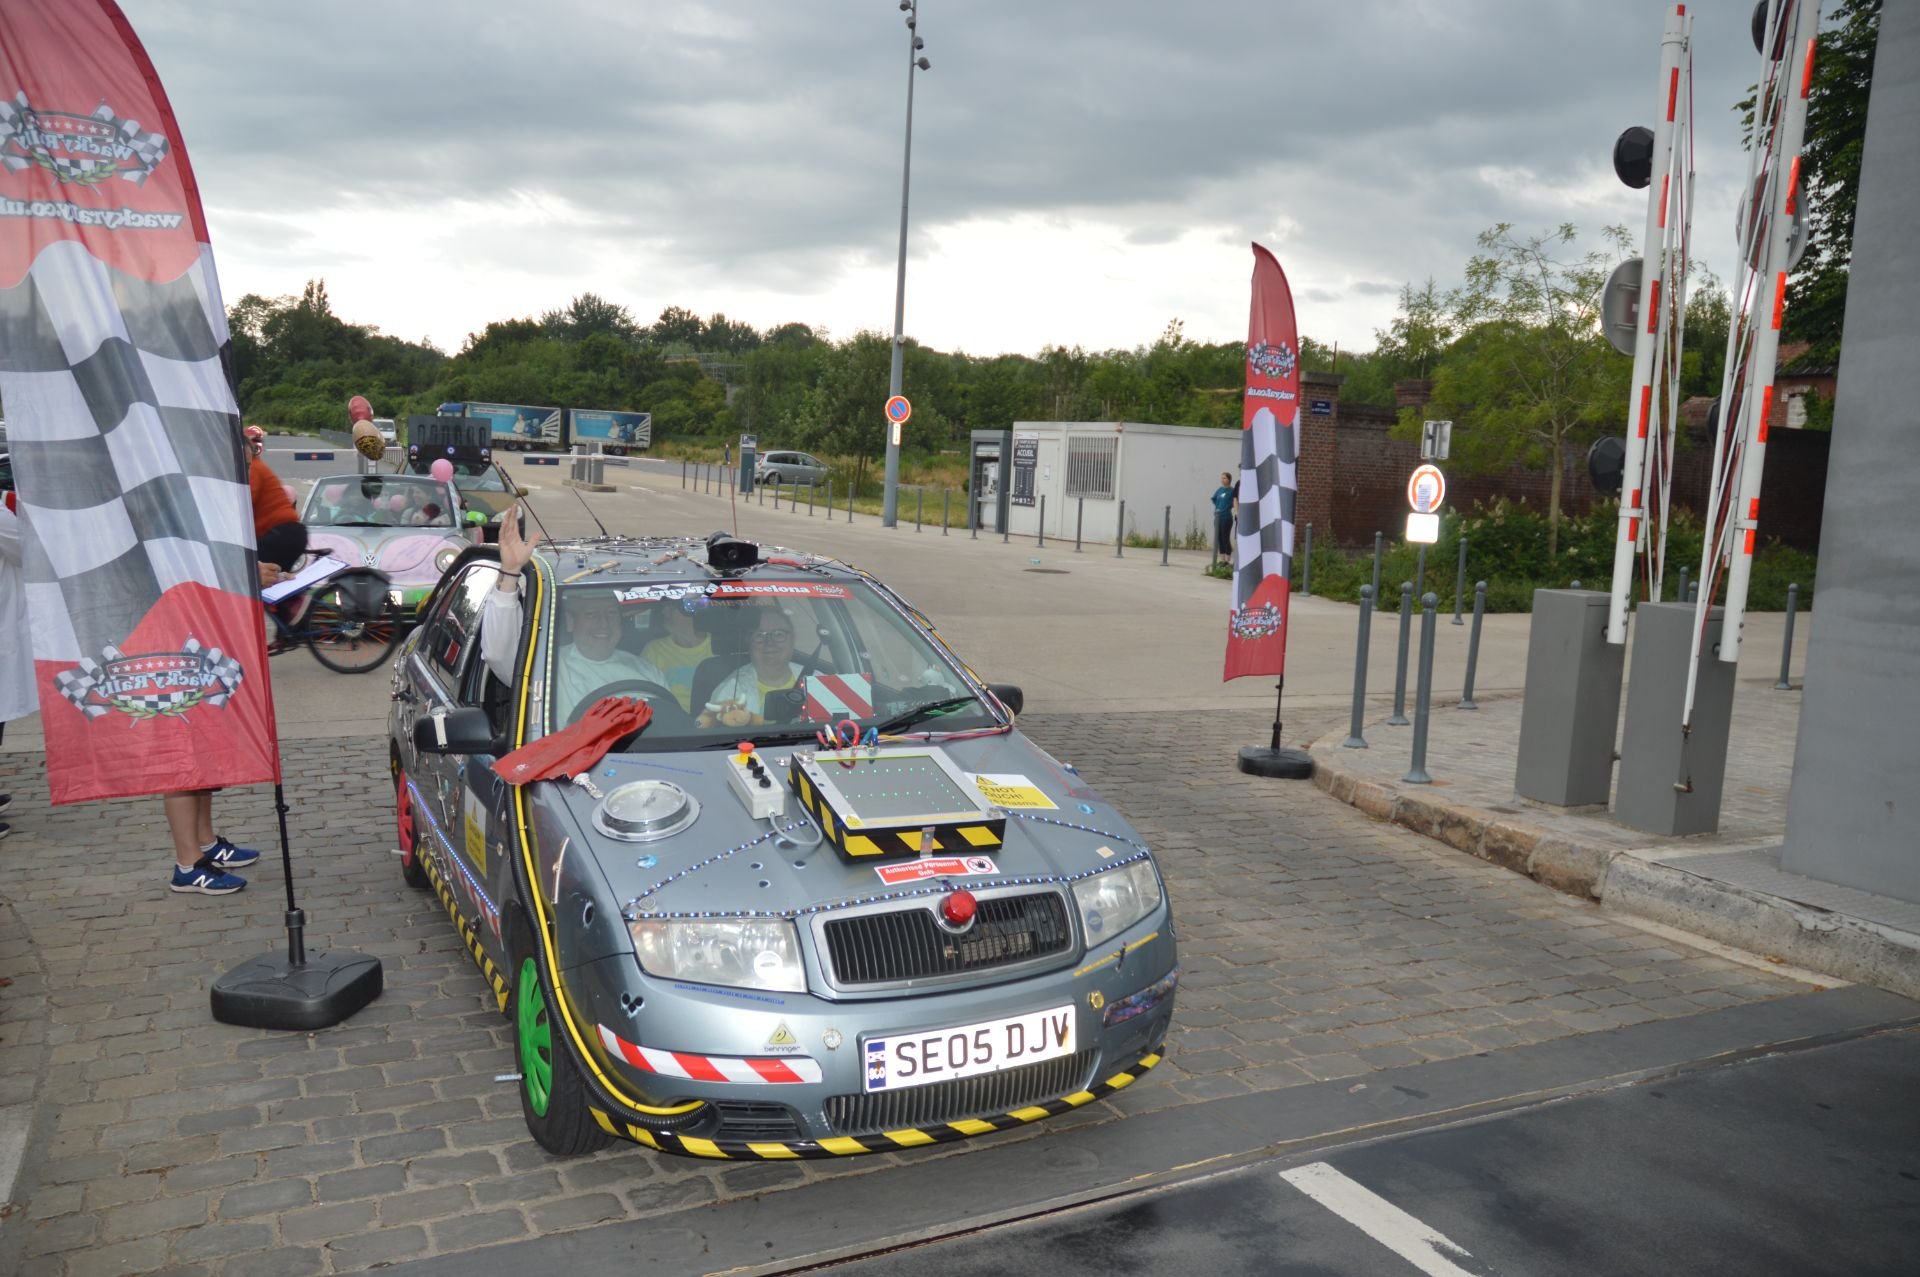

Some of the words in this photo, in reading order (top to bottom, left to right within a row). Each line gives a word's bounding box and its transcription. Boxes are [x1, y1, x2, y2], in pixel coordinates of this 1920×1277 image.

[623, 587, 688, 600] Barmy
[721, 584, 811, 594] Barcelona
[984, 791, 1024, 799] OUCH!
[884, 863, 923, 874] Authorised
[924, 859, 959, 869] Personnel
[918, 869, 935, 877] Only
[1006, 1012, 1068, 1059] DJV
[764, 1043, 799, 1053] behringer
